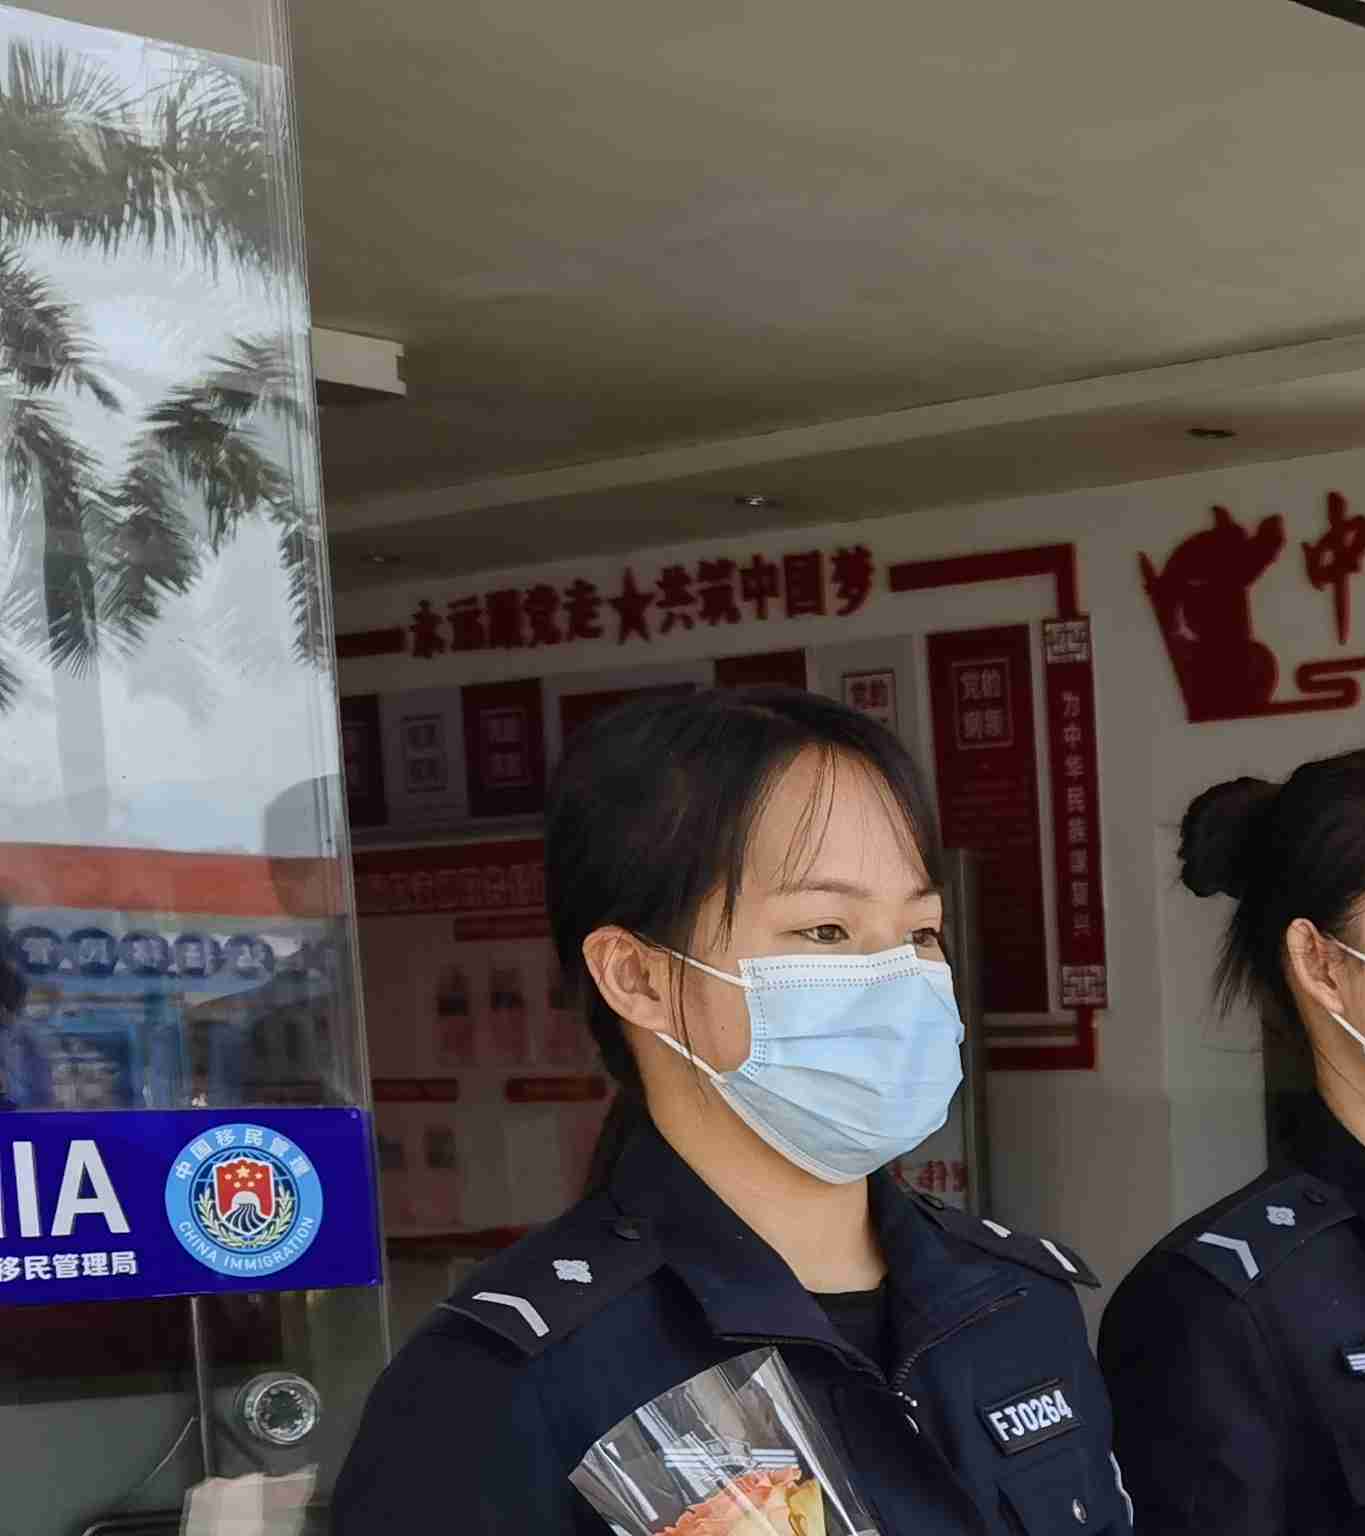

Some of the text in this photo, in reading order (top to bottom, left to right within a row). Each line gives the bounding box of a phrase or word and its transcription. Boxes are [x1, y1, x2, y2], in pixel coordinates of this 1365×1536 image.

[175, 1127, 311, 1182] 中国移民管理
[0, 1140, 131, 1238] IA
[0, 1251, 139, 1282] 移民管理局
[178, 1216, 314, 1272] CHINA IMMIGRATION
[988, 1389, 1073, 1441] FJ0264
